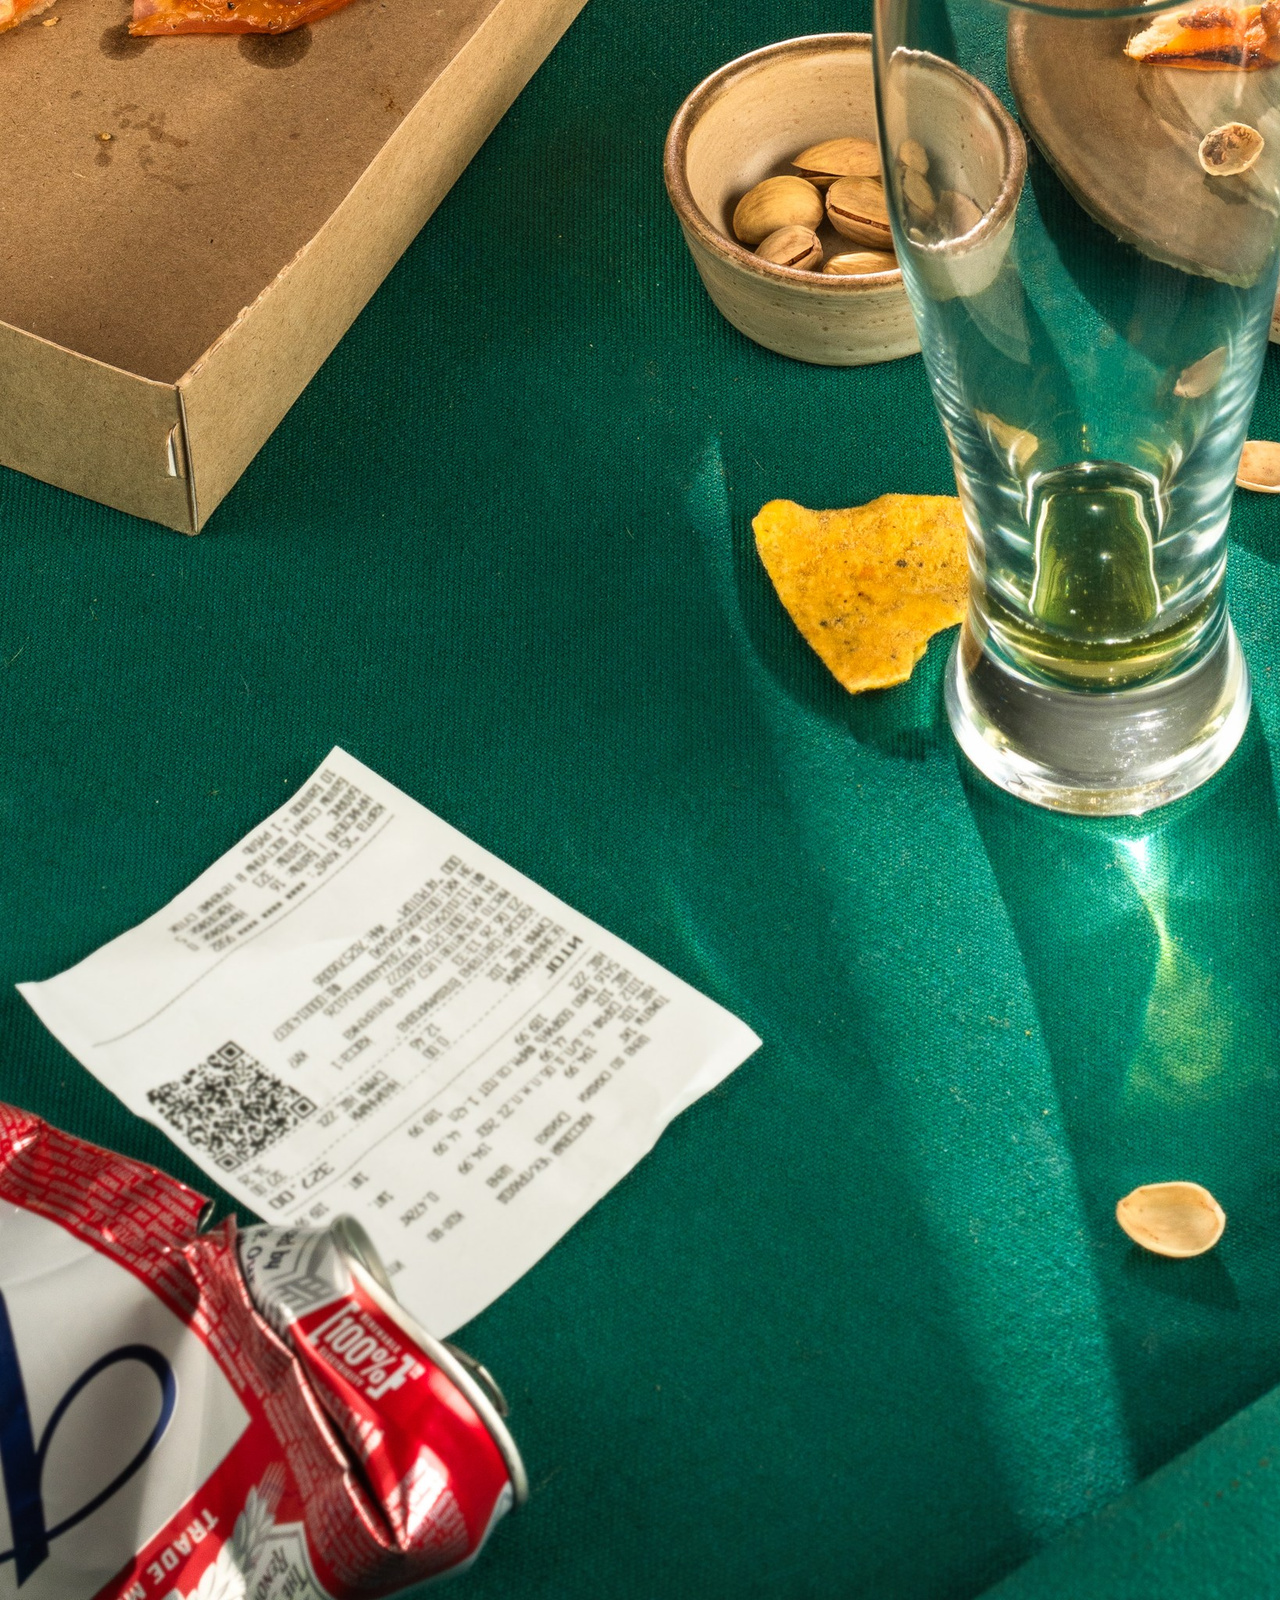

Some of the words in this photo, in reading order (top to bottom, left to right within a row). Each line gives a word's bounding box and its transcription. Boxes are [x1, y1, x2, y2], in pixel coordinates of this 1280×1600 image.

[319, 768, 336, 784] 10
[251, 869, 274, 888] 323
[268, 877, 286, 892] 16
[450, 938, 482, 967] 13:33
[545, 935, 583, 977] ИТОГ
[593, 959, 620, 984] 5416
[571, 984, 597, 1008] ПИВО
[618, 976, 645, 1002] 1012
[408, 1022, 440, 1050] 12.46
[513, 1013, 548, 1046] 189.99
[421, 1035, 449, 1059] 0.00
[538, 1035, 566, 1062] 44.99
[563, 1045, 597, 1078] 194.99
[407, 1108, 443, 1138] 189.99
[432, 1129, 460, 1156] 44.99
[457, 1142, 492, 1175] 194.99
[267, 1161, 334, 1210] 327.00
[144, 1506, 219, 1585] TRADE
